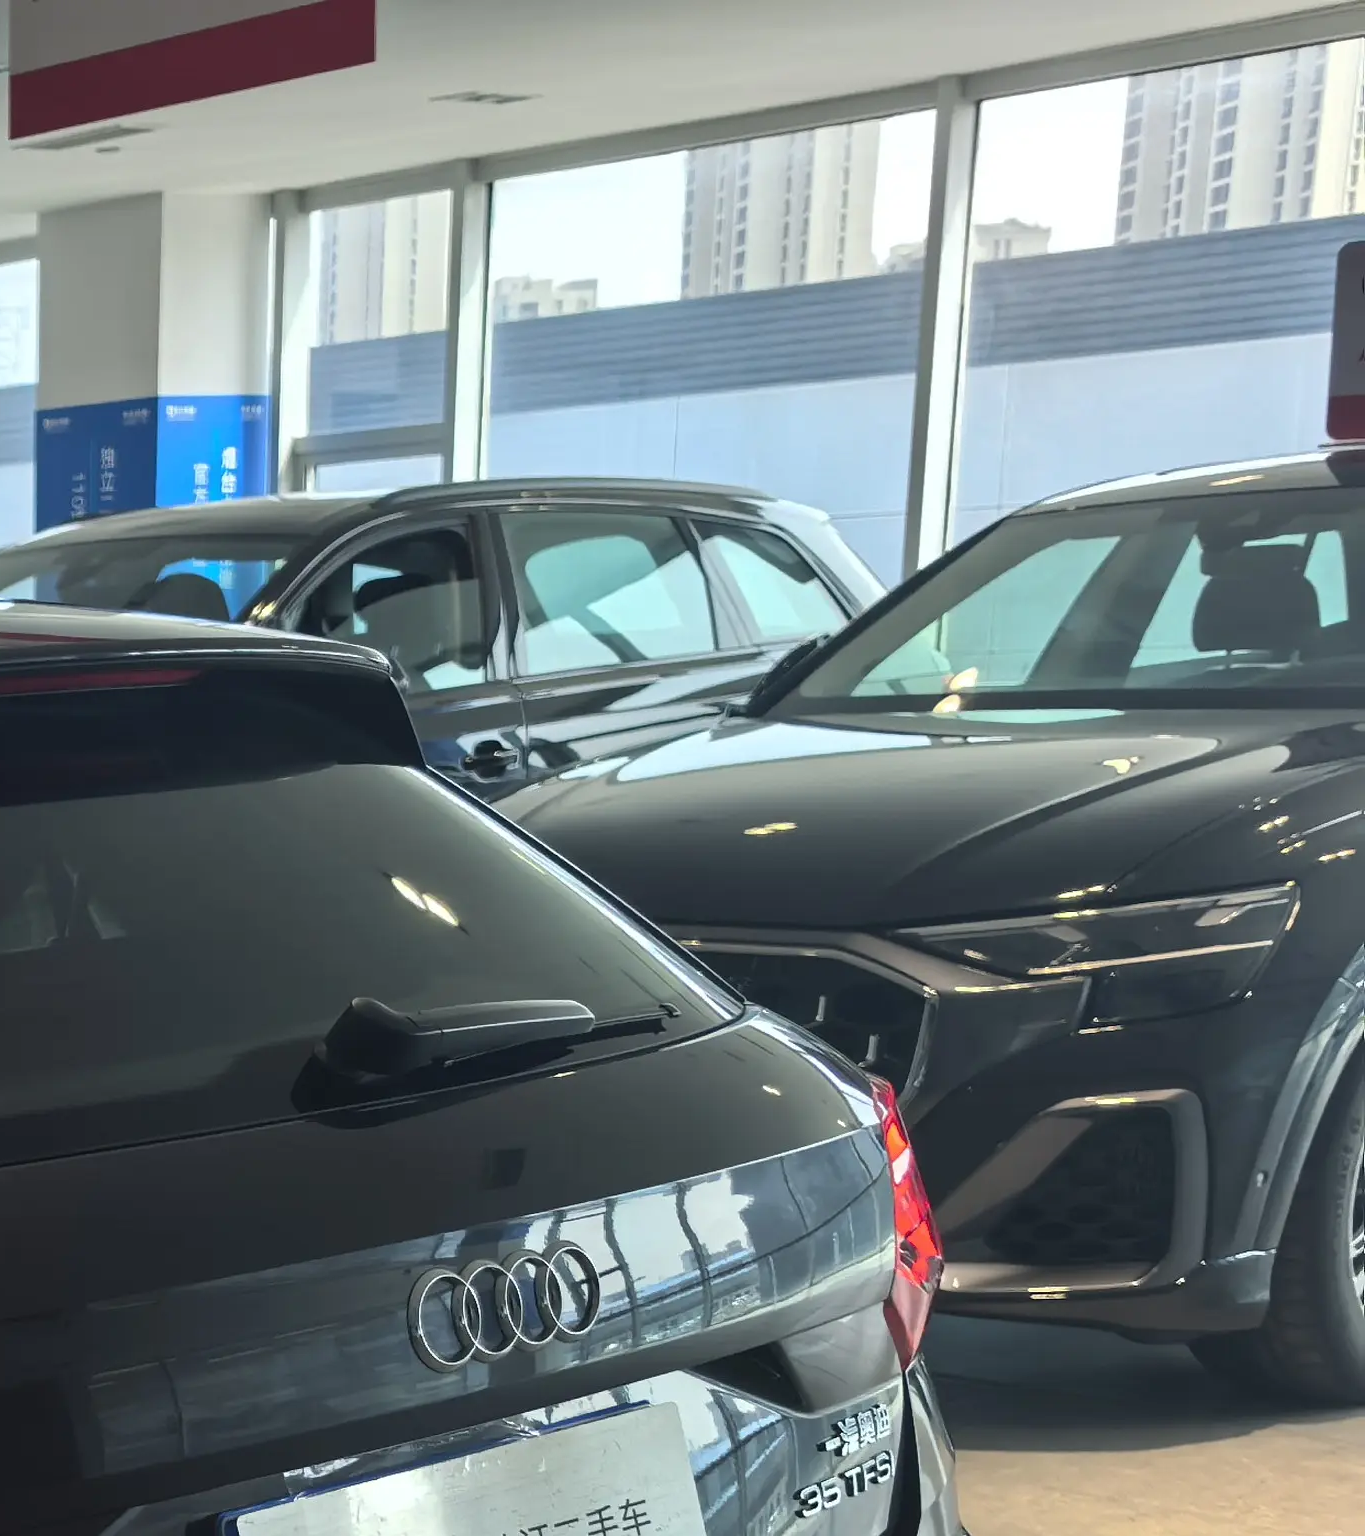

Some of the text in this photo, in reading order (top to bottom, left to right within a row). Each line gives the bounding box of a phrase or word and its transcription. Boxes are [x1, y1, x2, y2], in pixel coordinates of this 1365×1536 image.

[819, 1403, 891, 1456] 一汽奥迪
[798, 1475, 842, 1518] 35
